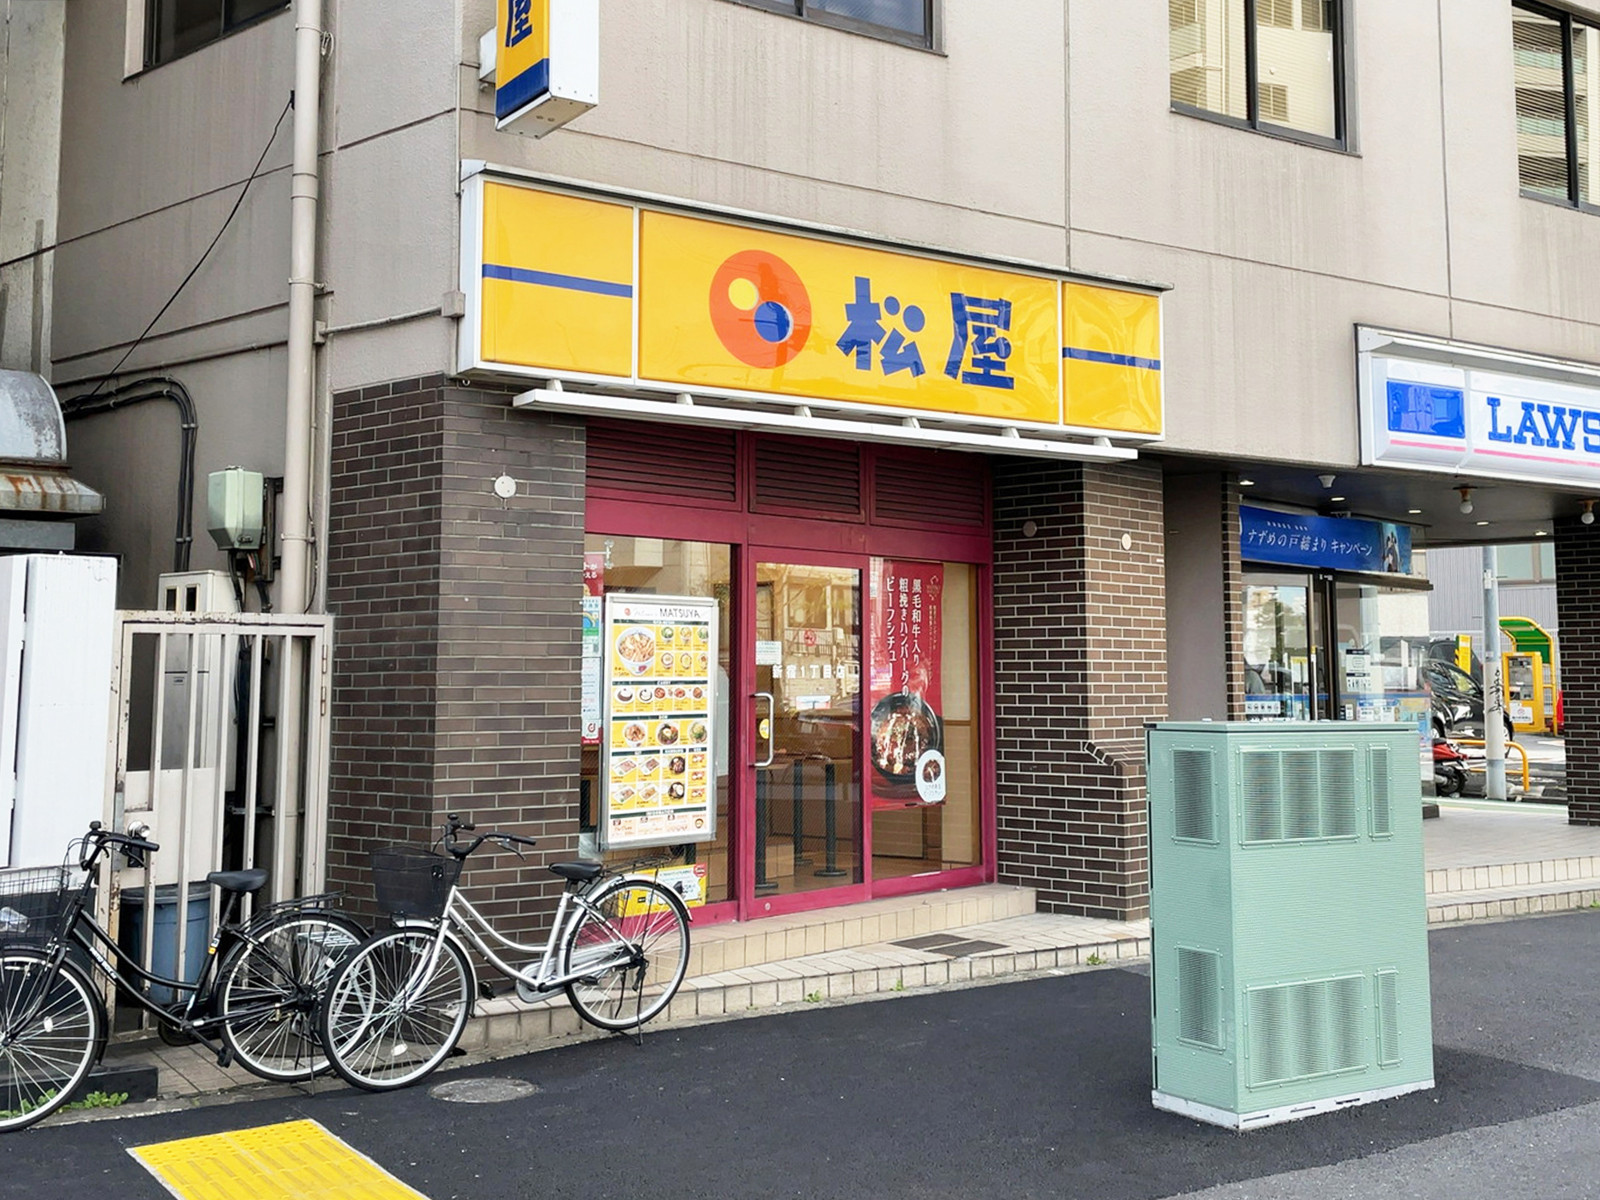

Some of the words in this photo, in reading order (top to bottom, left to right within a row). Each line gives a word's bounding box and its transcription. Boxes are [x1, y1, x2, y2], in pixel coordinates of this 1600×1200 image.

[835, 276, 1015, 390] 松屋
[1486, 396, 1600, 454] LAWS
[1247, 529, 1327, 552] すずめの戸締まり
[1331, 541, 1373, 557] キャンペーン
[659, 607, 701, 619] MATSUYA
[885, 576, 897, 679] ビーフシチュー
[911, 578, 922, 666] 黒毛和牛入り
